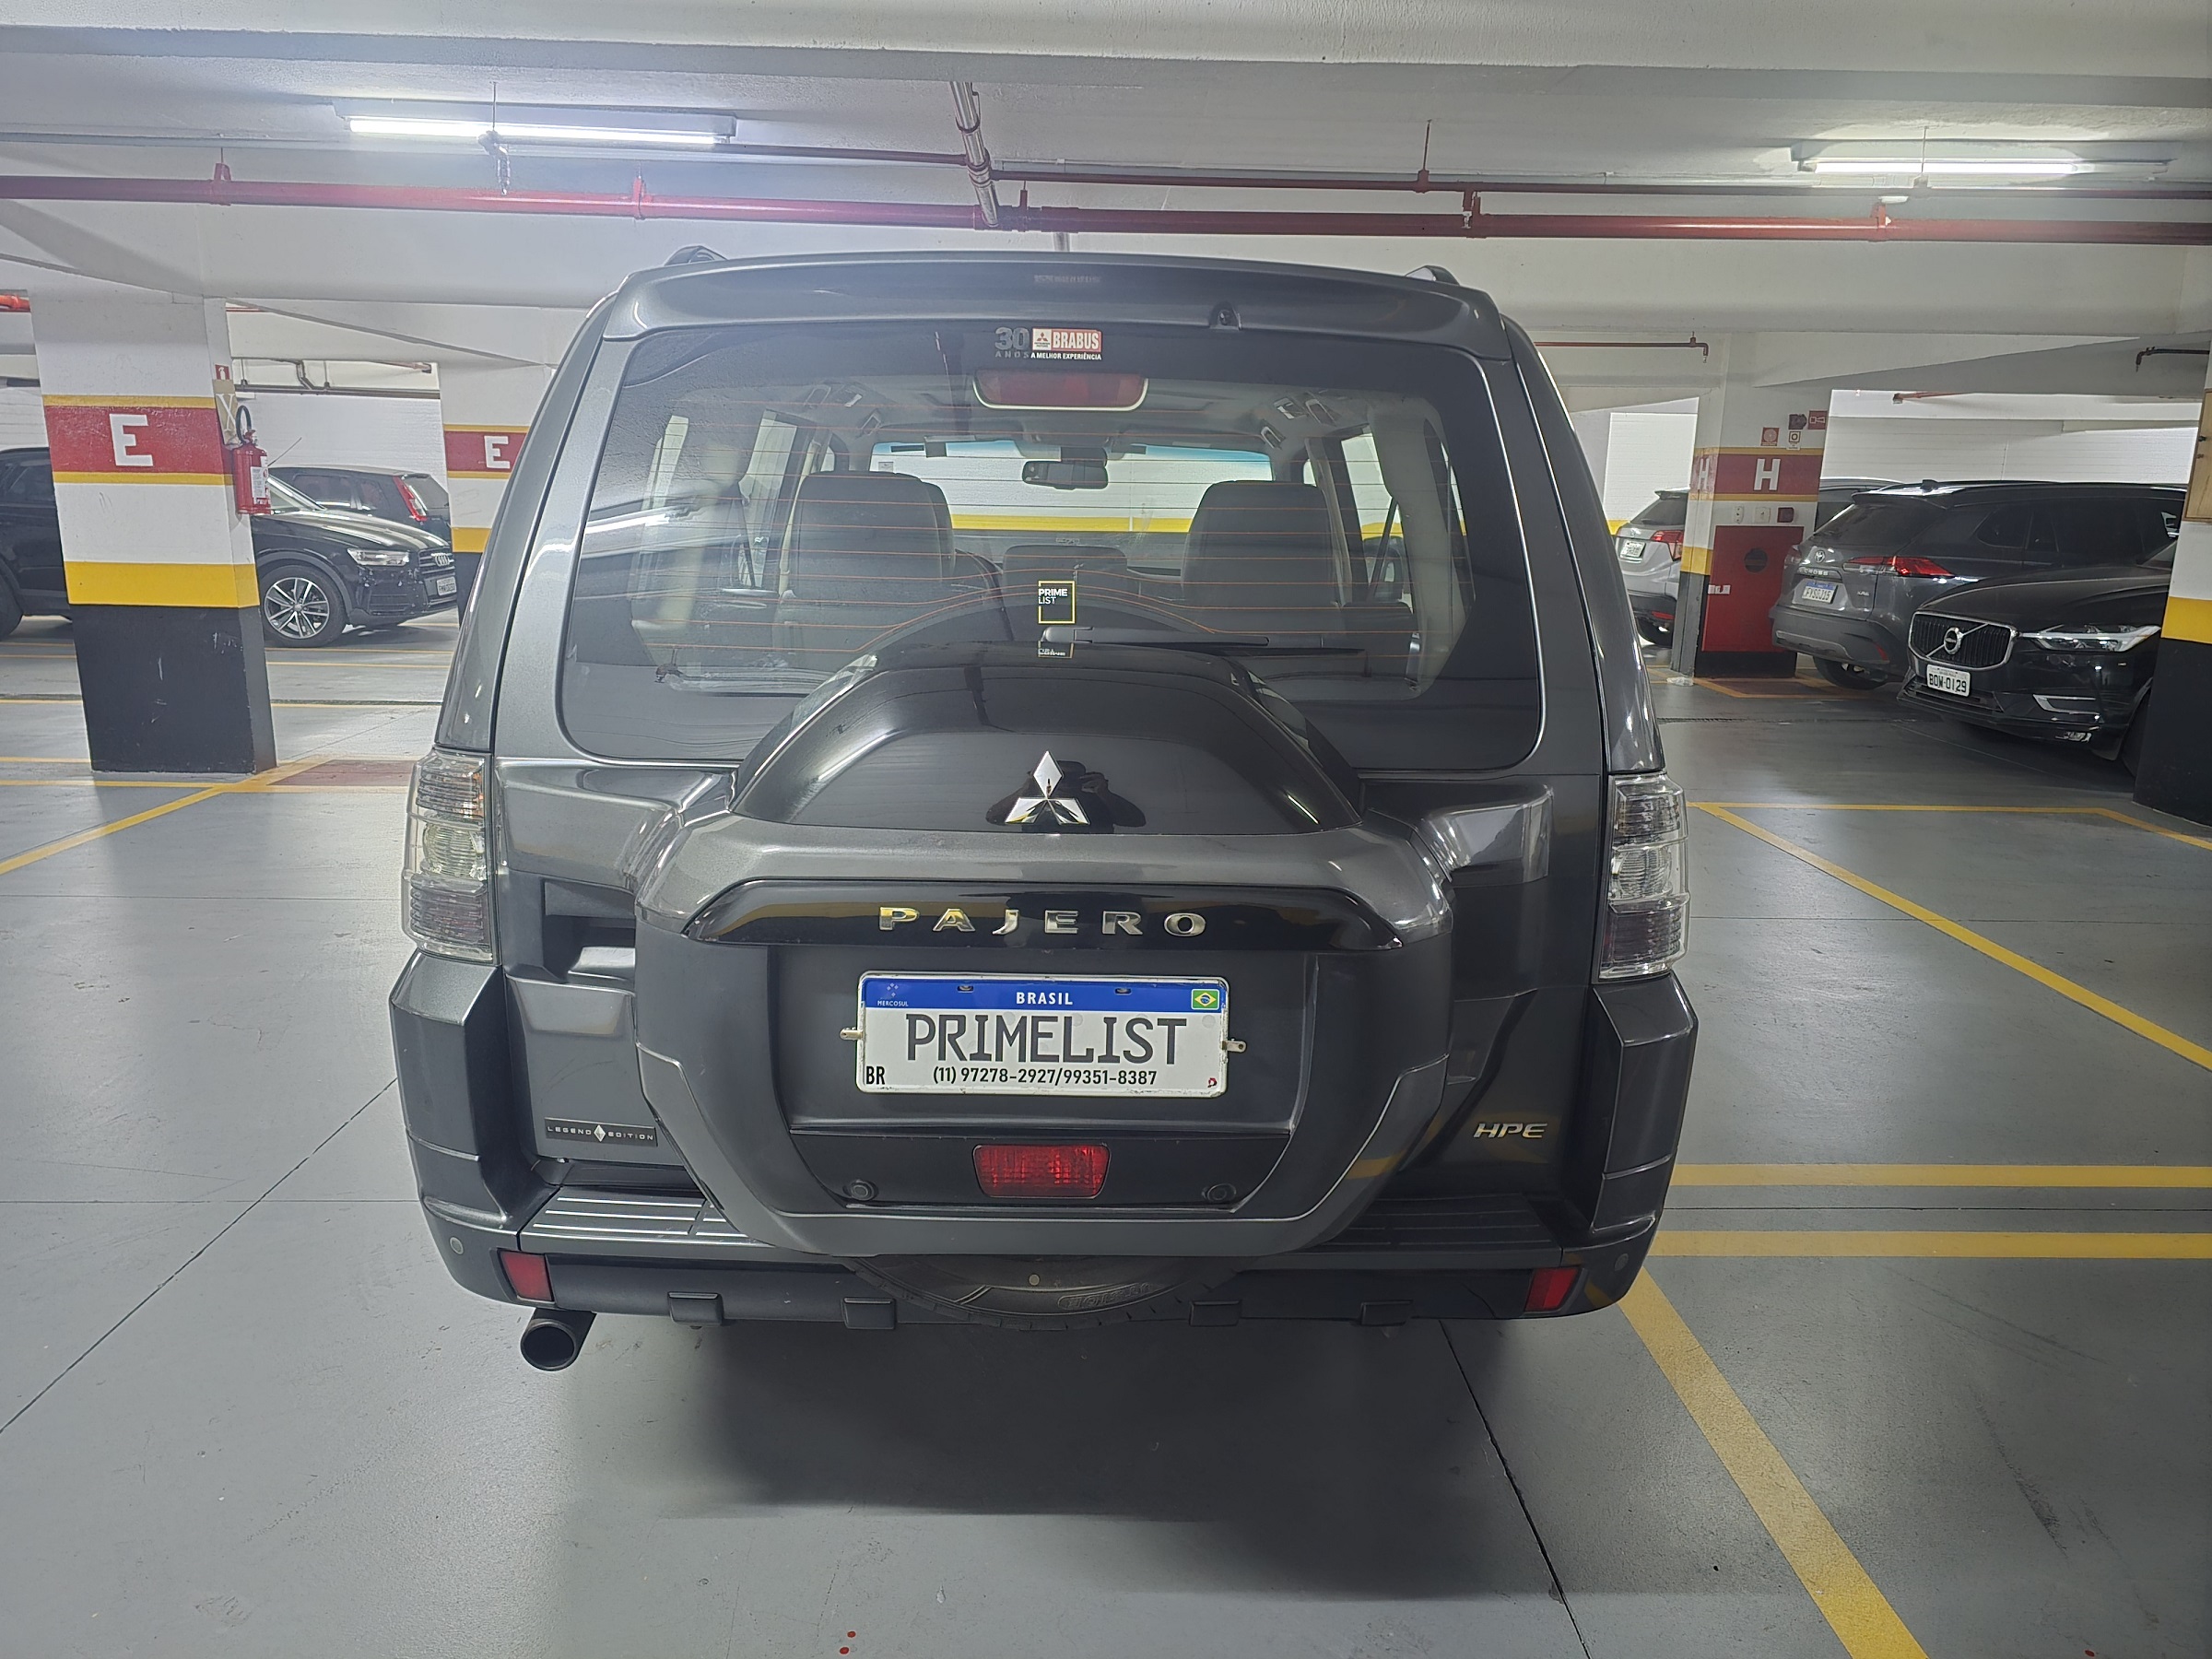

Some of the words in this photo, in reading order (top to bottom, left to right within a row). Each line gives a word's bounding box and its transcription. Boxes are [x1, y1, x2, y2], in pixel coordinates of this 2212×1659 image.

[994, 326, 1030, 350] 30
[1053, 330, 1100, 350] BRABUS
[1063, 352, 1102, 360] EXPERIÊNCIA
[109, 413, 154, 467] E
[484, 435, 511, 469] E
[1753, 458, 1782, 491] H
[1038, 588, 1068, 597] PRIME
[1038, 596, 1057, 605] LIST
[877, 906, 1207, 938] PAJERO
[877, 999, 910, 1007] MERCOSUL
[1015, 991, 1074, 1006] BRASIL
[906, 1013, 1187, 1065] PRIMELIST
[865, 1065, 886, 1086] BR
[933, 1067, 957, 1084] (11)
[960, 1067, 1158, 1086] 97278-2927/99351-8387
[547, 1125, 592, 1135] LEGEND
[607, 1131, 653, 1141] EDITION
[1473, 1123, 1548, 1138] HPE
